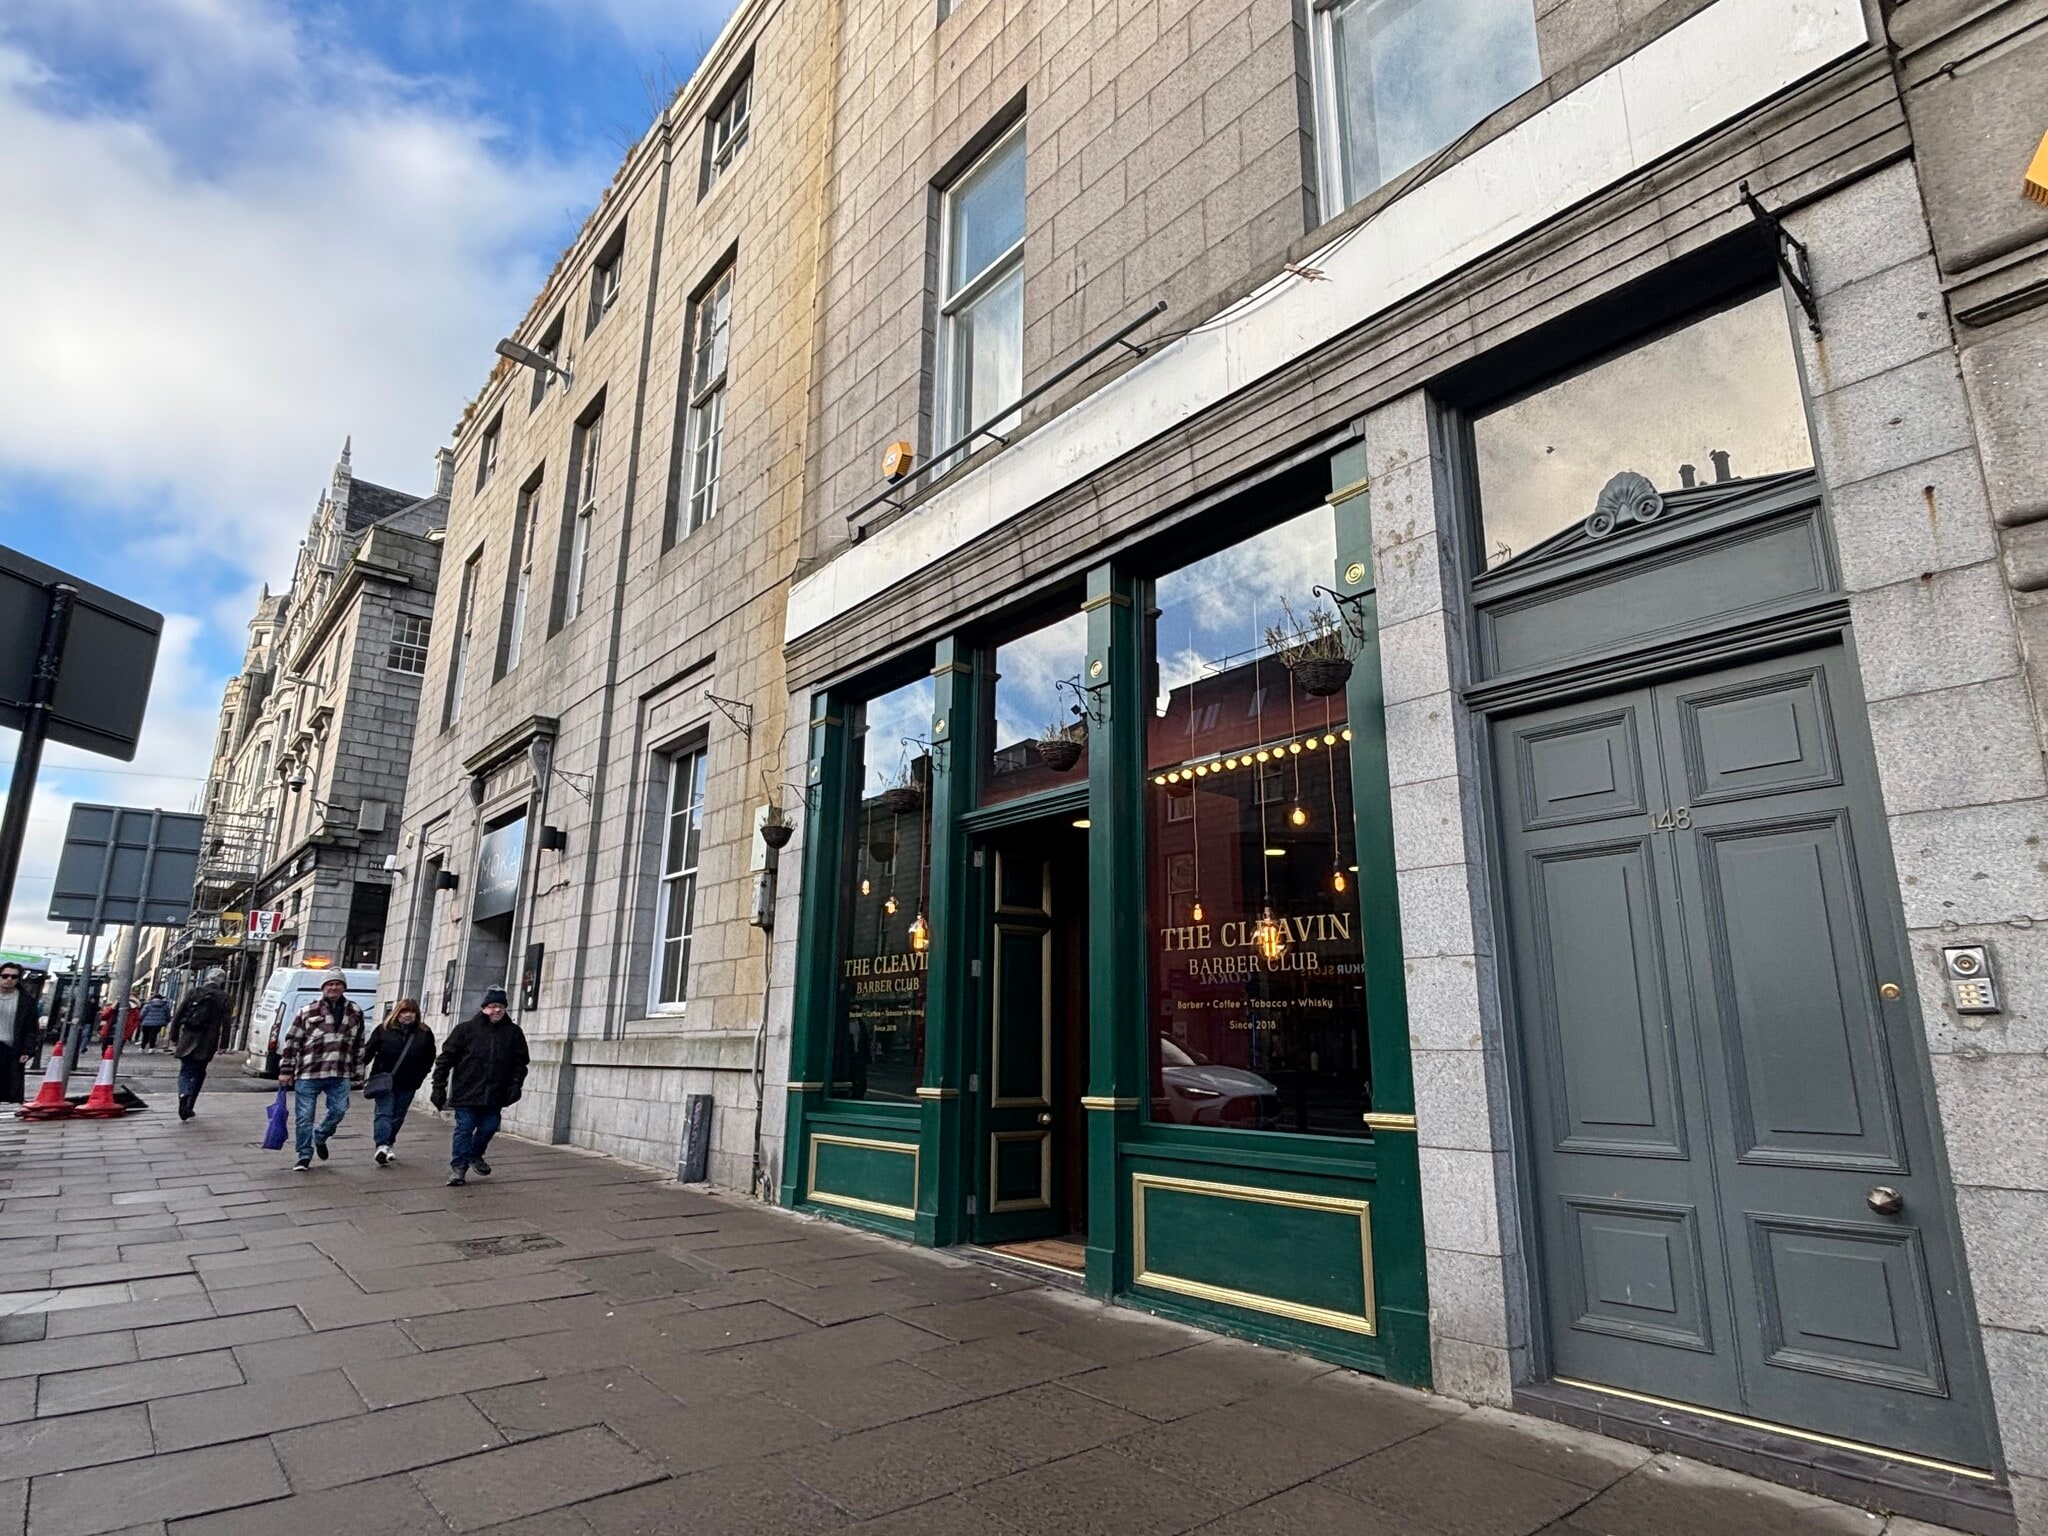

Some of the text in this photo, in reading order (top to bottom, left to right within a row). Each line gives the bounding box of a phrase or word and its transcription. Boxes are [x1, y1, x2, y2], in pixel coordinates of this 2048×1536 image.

[1648, 806, 1691, 834] 148
[1160, 924, 1212, 951] THE
[844, 958, 871, 977] THE
[1189, 951, 1318, 976] BARBER CLUB
[856, 977, 920, 994] BARBER CLUB
[1177, 997, 1333, 1009] Barber Coffee Tobacco Whisky
[1229, 1020, 1276, 1030] Since 2018
